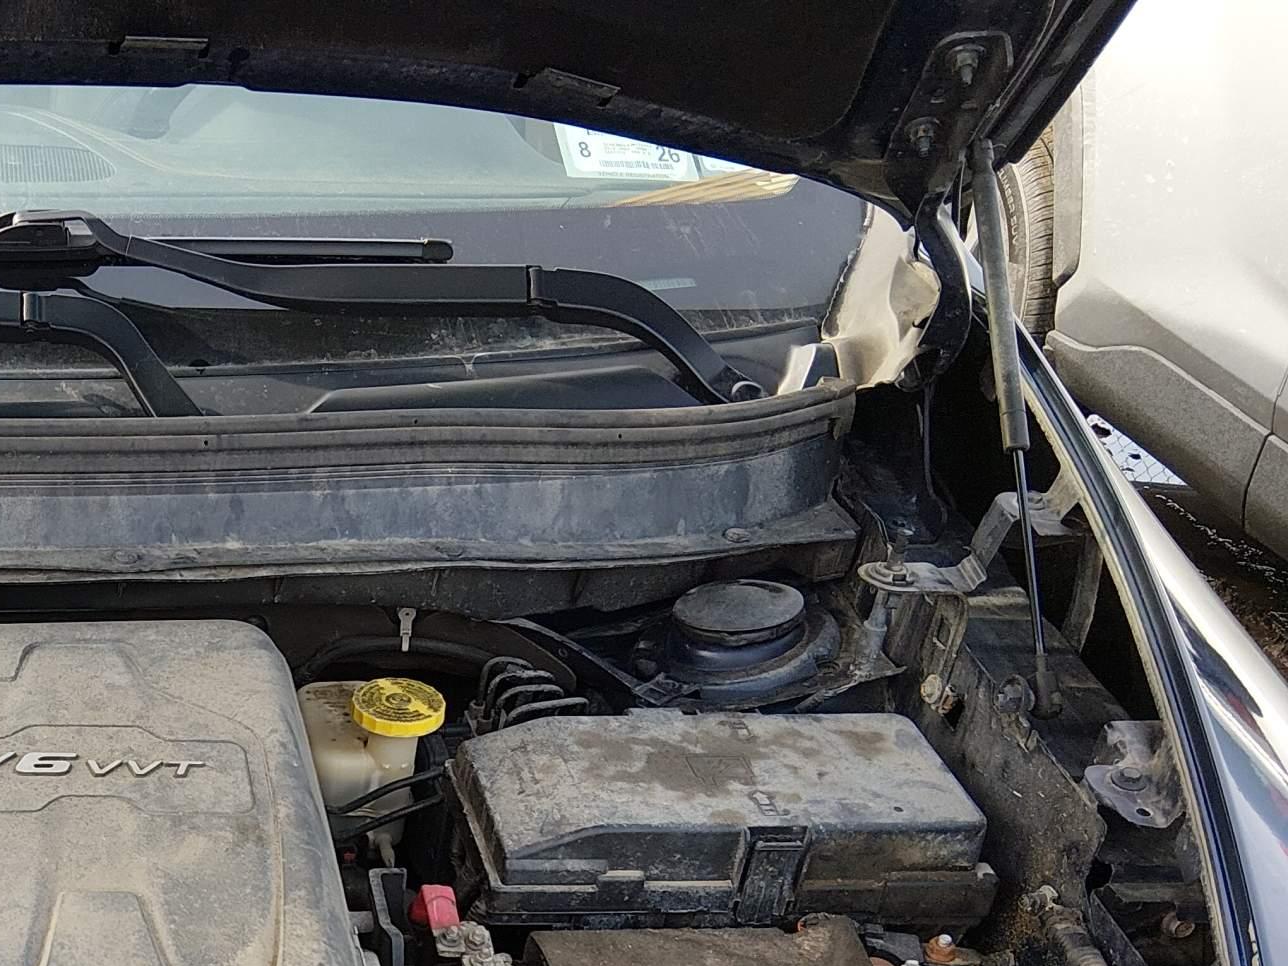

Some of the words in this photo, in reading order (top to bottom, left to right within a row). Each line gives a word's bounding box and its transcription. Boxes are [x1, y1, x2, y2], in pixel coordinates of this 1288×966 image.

[578, 141, 591, 158] 8
[656, 145, 680, 163] 26
[87, 760, 206, 777] VVT
